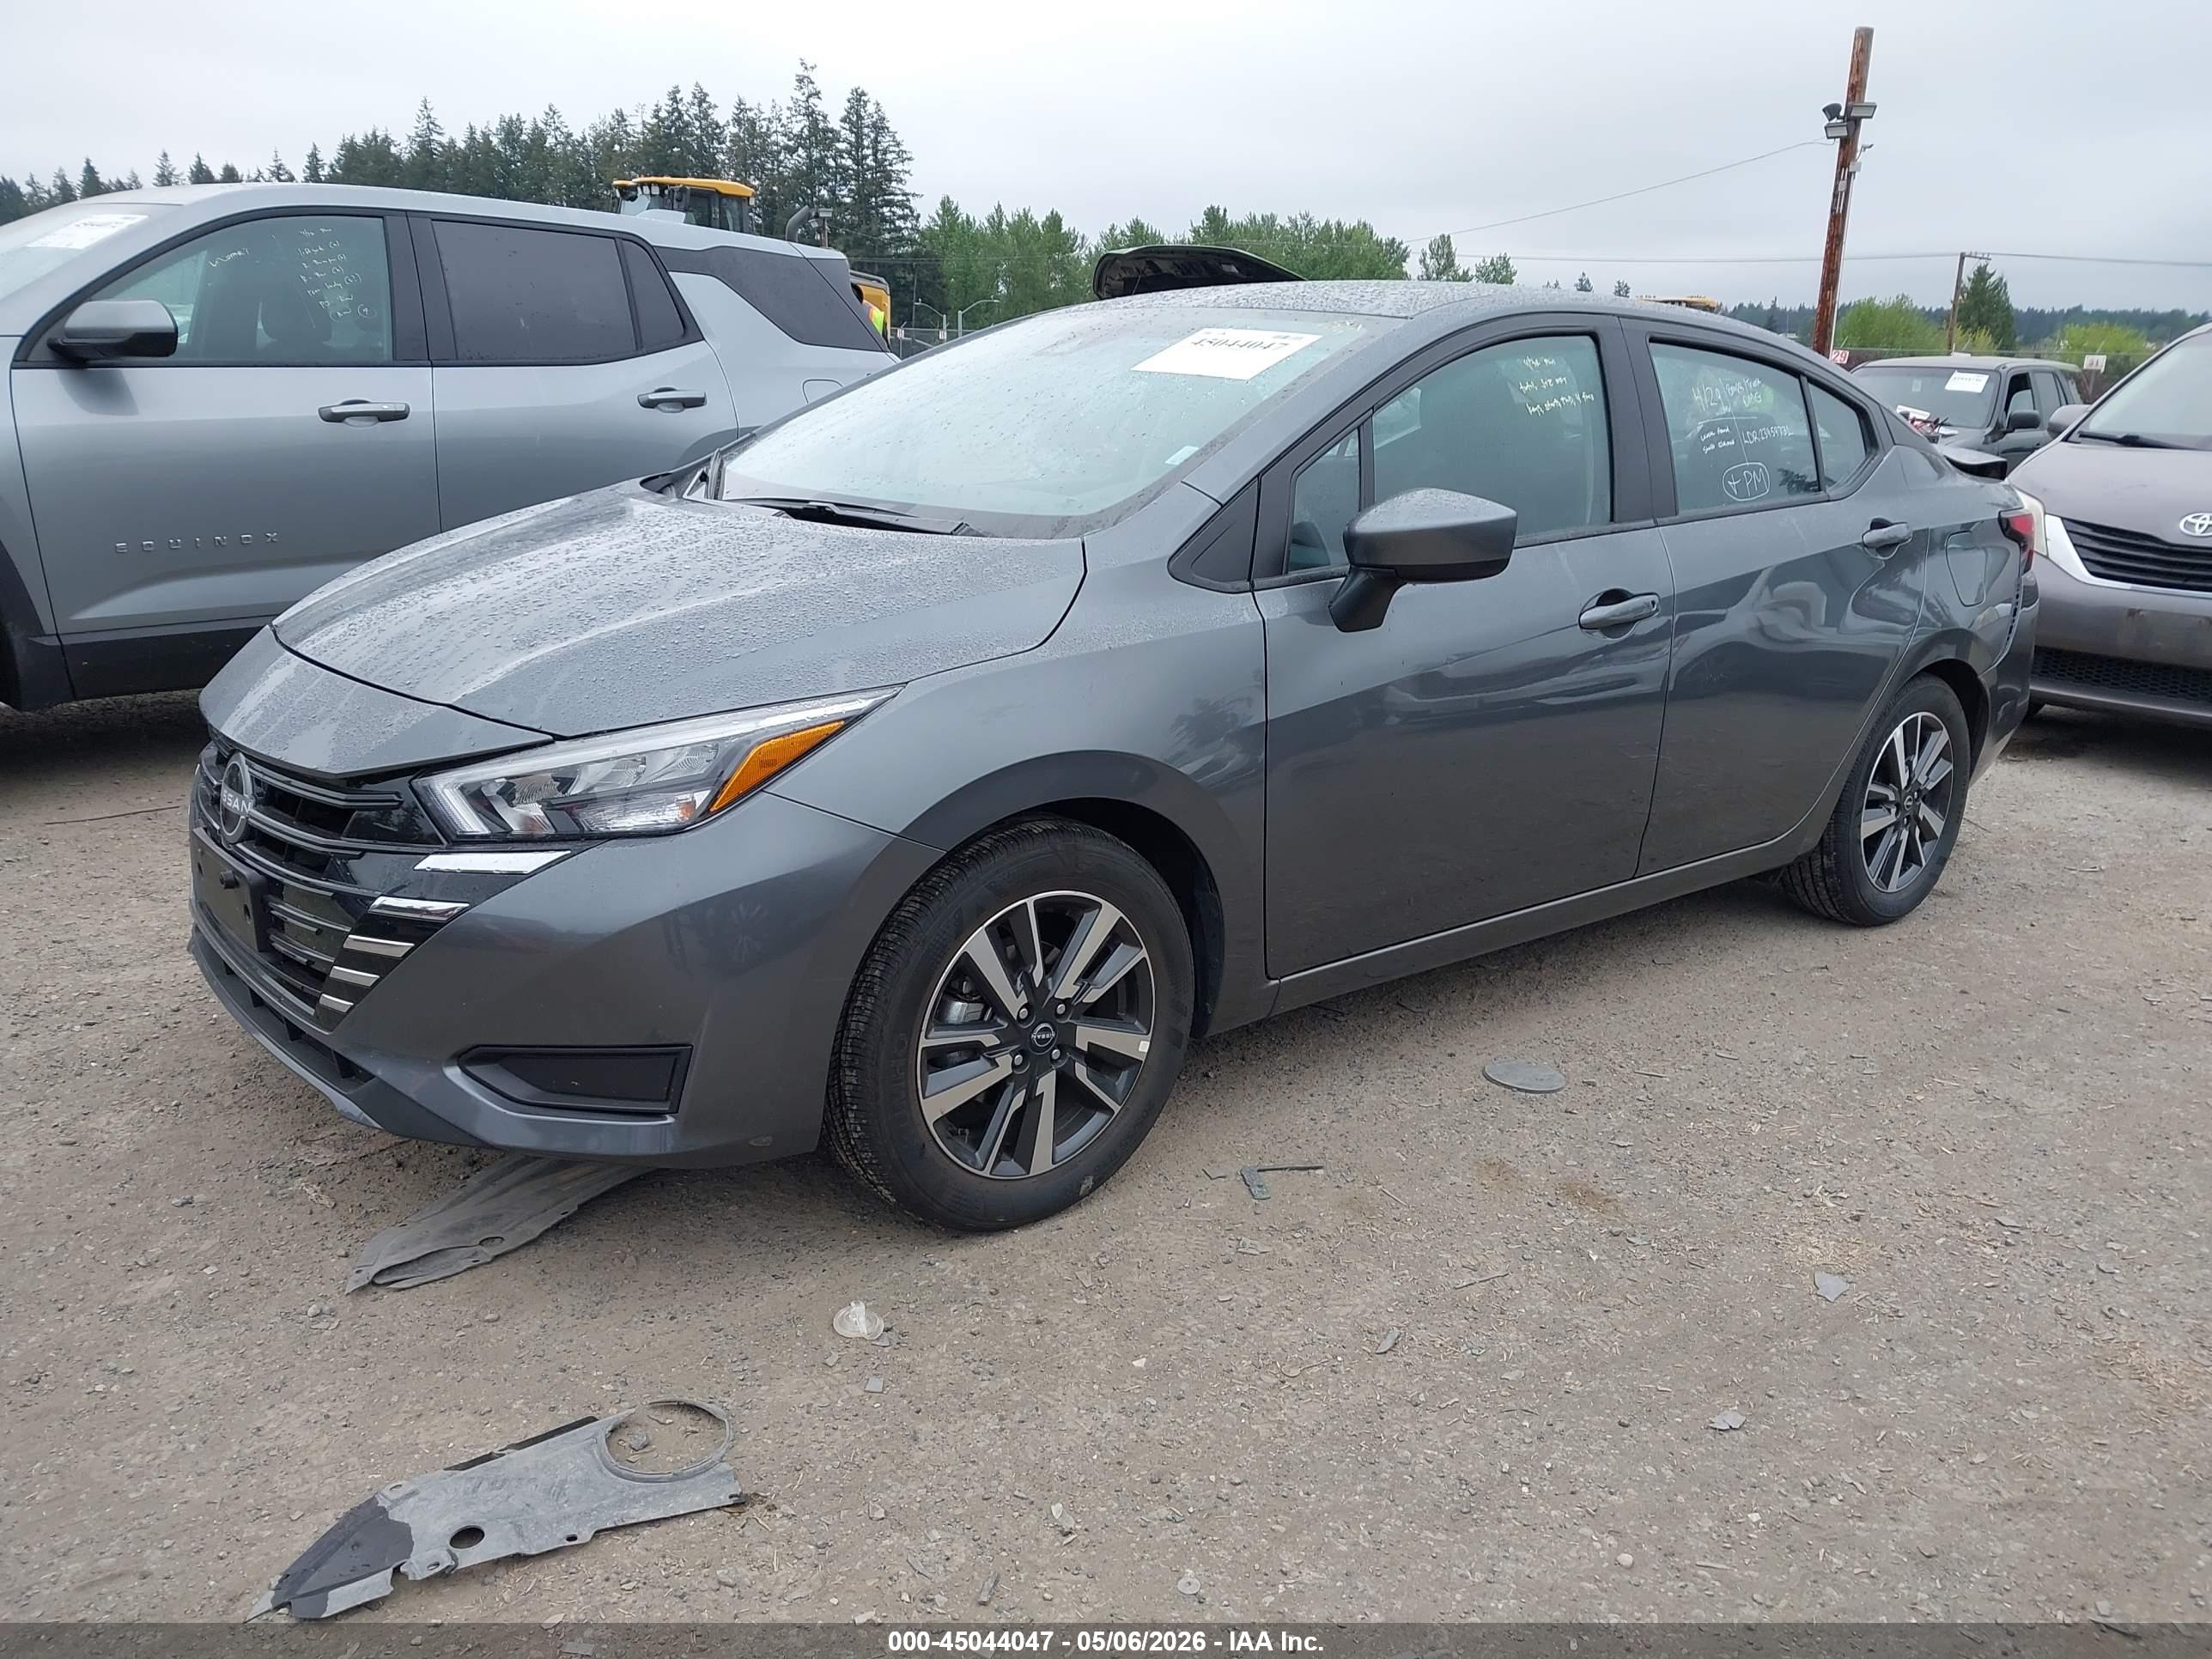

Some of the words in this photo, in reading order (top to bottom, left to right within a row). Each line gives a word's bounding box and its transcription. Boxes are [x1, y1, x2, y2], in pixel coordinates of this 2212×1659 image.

[1832, 351, 1848, 362] 29
[115, 532, 278, 552] EQUINOX
[222, 790, 252, 813] SSAN
